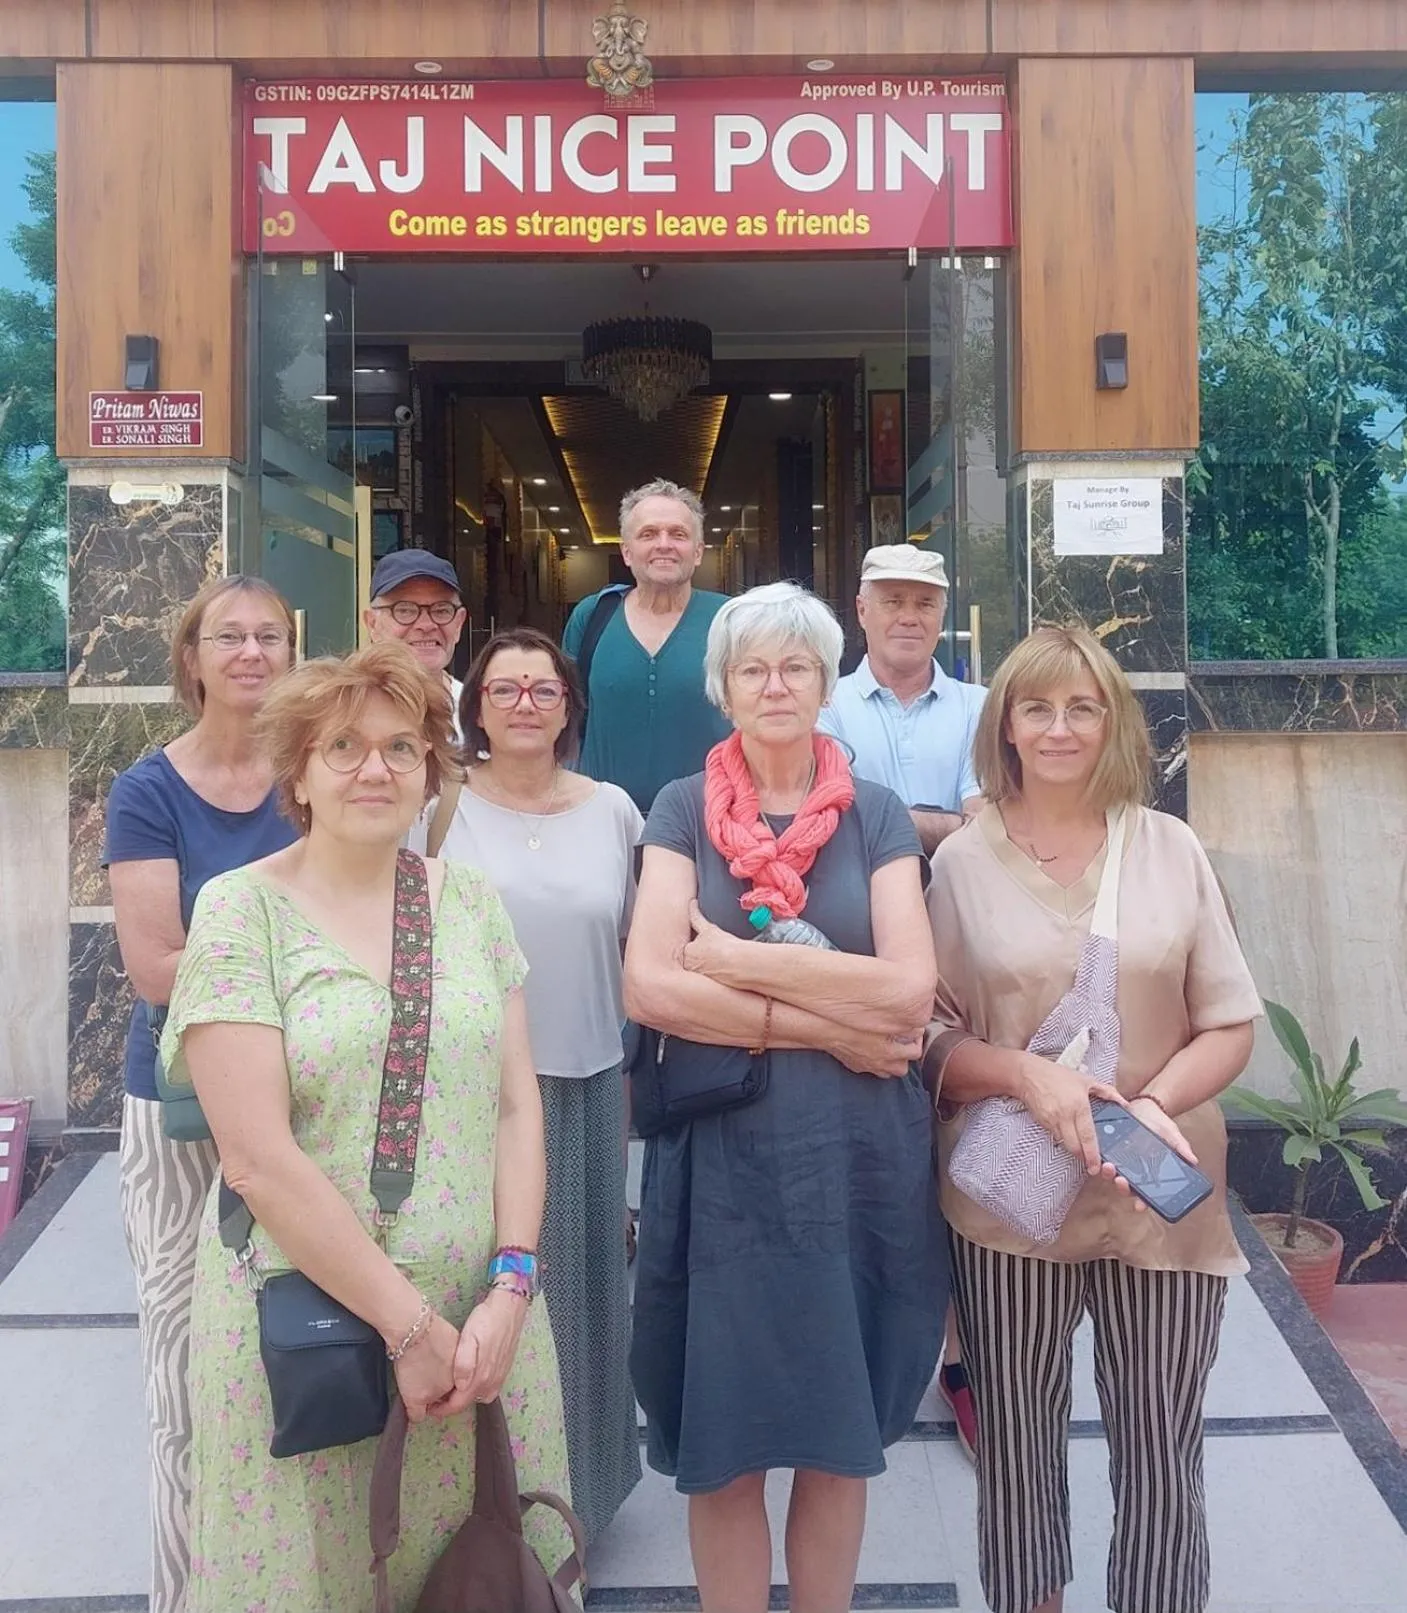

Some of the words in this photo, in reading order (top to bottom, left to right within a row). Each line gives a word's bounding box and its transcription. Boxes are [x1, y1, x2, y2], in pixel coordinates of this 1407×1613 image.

[254, 85, 312, 101] GSTIN:
[316, 84, 474, 100] 09GZFPS7414L1ZM
[801, 80, 876, 101] Approved
[881, 80, 902, 99] By
[907, 80, 936, 96] U.P.
[941, 80, 1005, 97] Tourism
[253, 115, 426, 194] TAJ
[464, 113, 677, 193] NICE
[714, 112, 1002, 192] POINT
[389, 209, 467, 236] Come
[475, 215, 508, 236] as
[516, 210, 648, 243] strangers
[656, 209, 728, 236] leave
[736, 215, 768, 235] as
[776, 208, 871, 235] friends
[93, 397, 145, 419] Pritam
[148, 396, 199, 419] Niwas
[115, 424, 157, 434] VIKRAM
[160, 423, 191, 433] SINGH
[115, 434, 155, 444] SONALI
[157, 434, 191, 444] SINGH
[1067, 501, 1081, 510] Taj
[1084, 500, 1118, 509] Sunrise
[1120, 499, 1151, 508] Group
